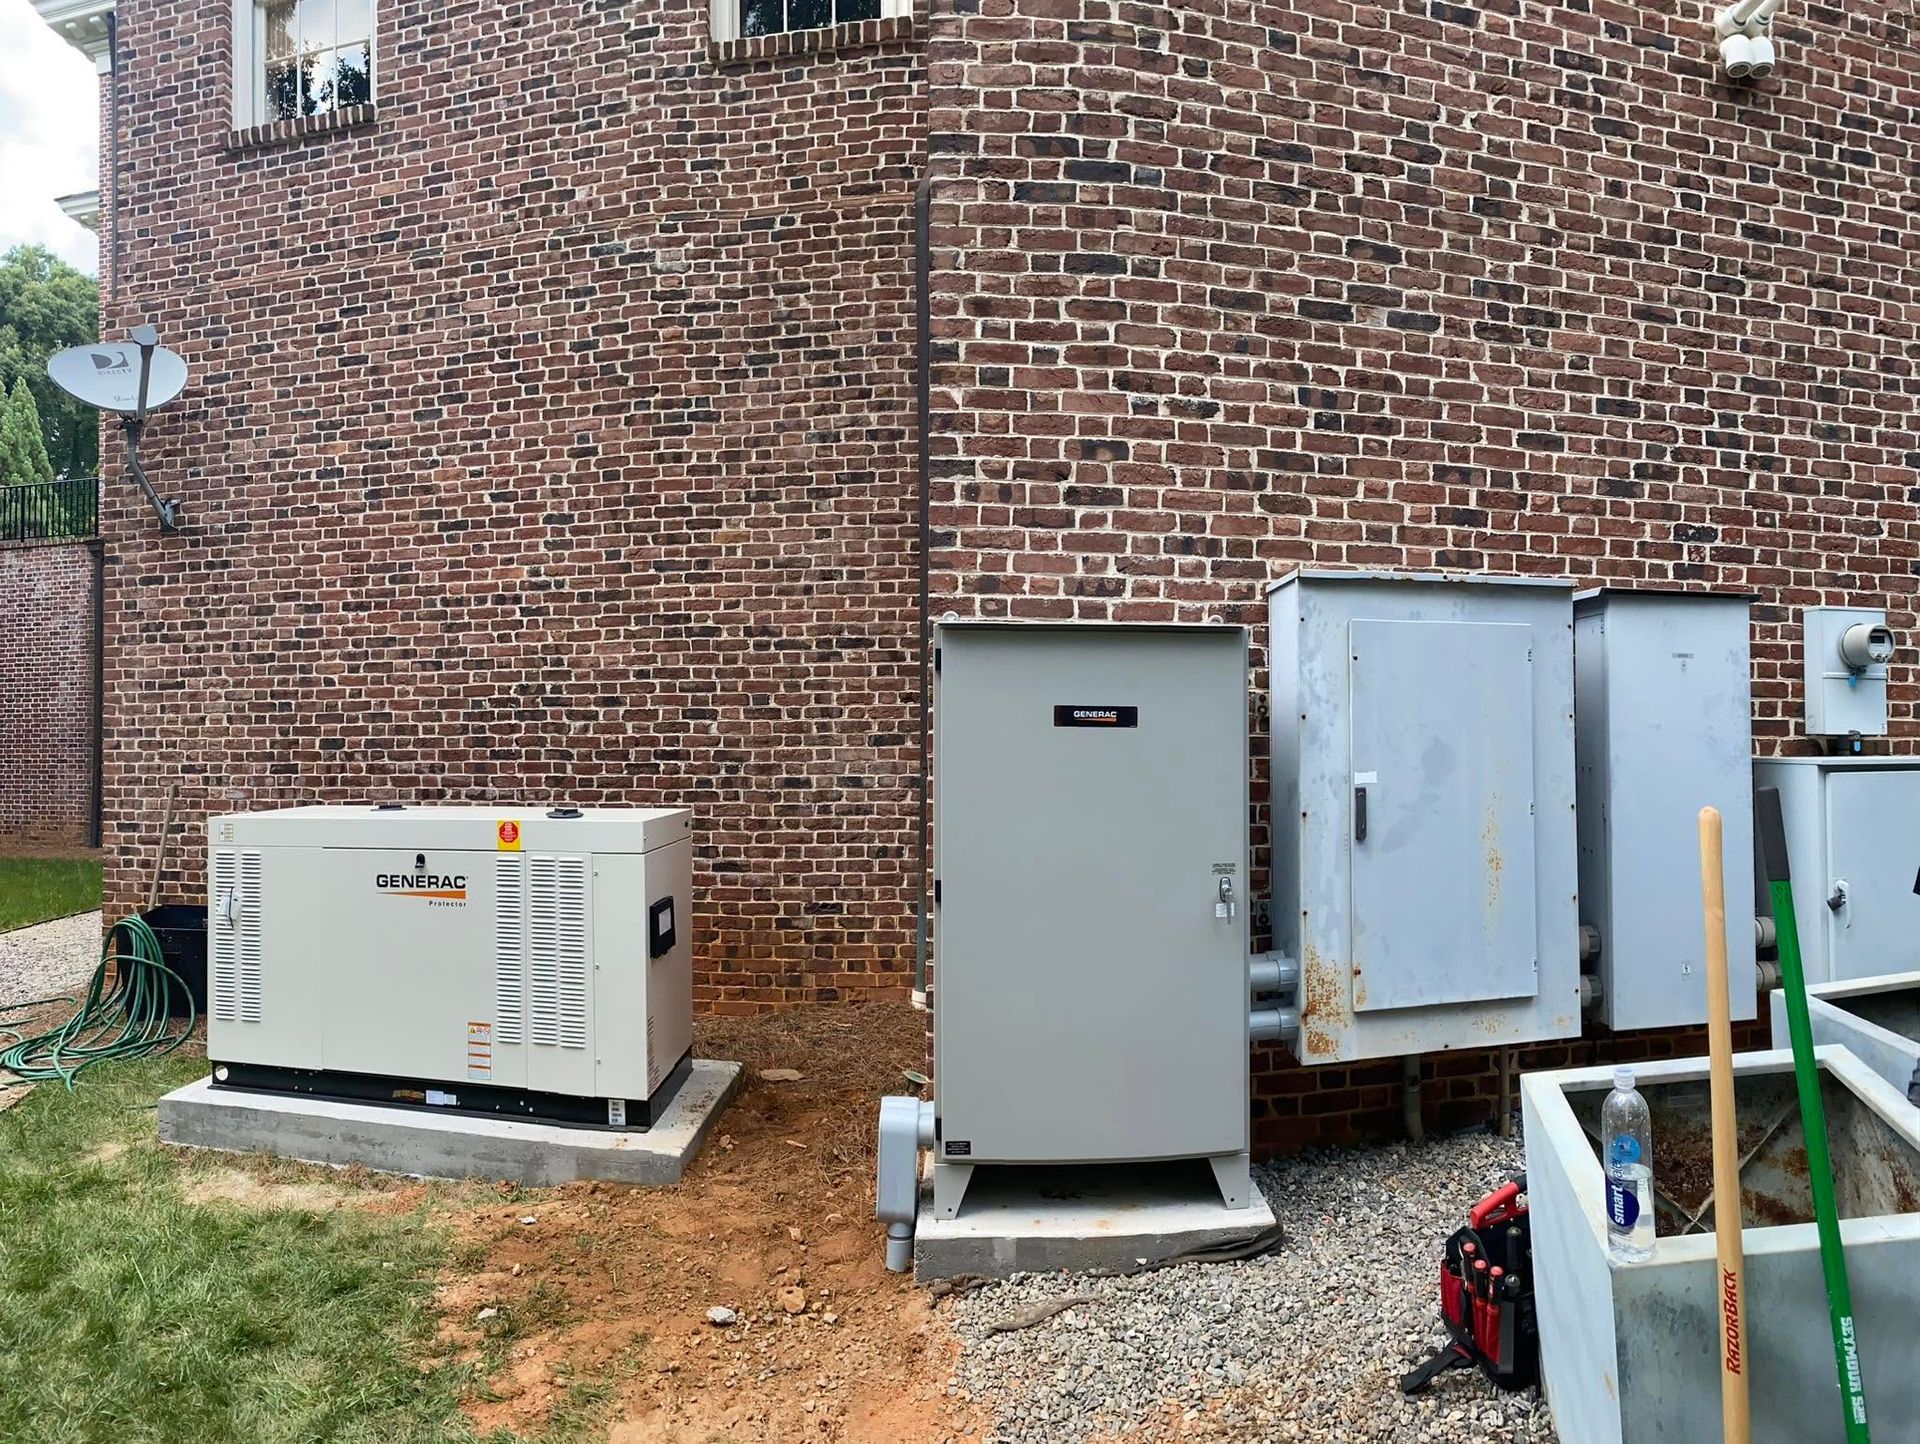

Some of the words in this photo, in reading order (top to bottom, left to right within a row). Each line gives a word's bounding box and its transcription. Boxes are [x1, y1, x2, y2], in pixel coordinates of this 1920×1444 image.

[1073, 710, 1117, 718] GENERAC
[376, 874, 466, 889] GENERAC
[428, 900, 467, 908] Protector
[1840, 1316, 1862, 1393] SEYMOUR
